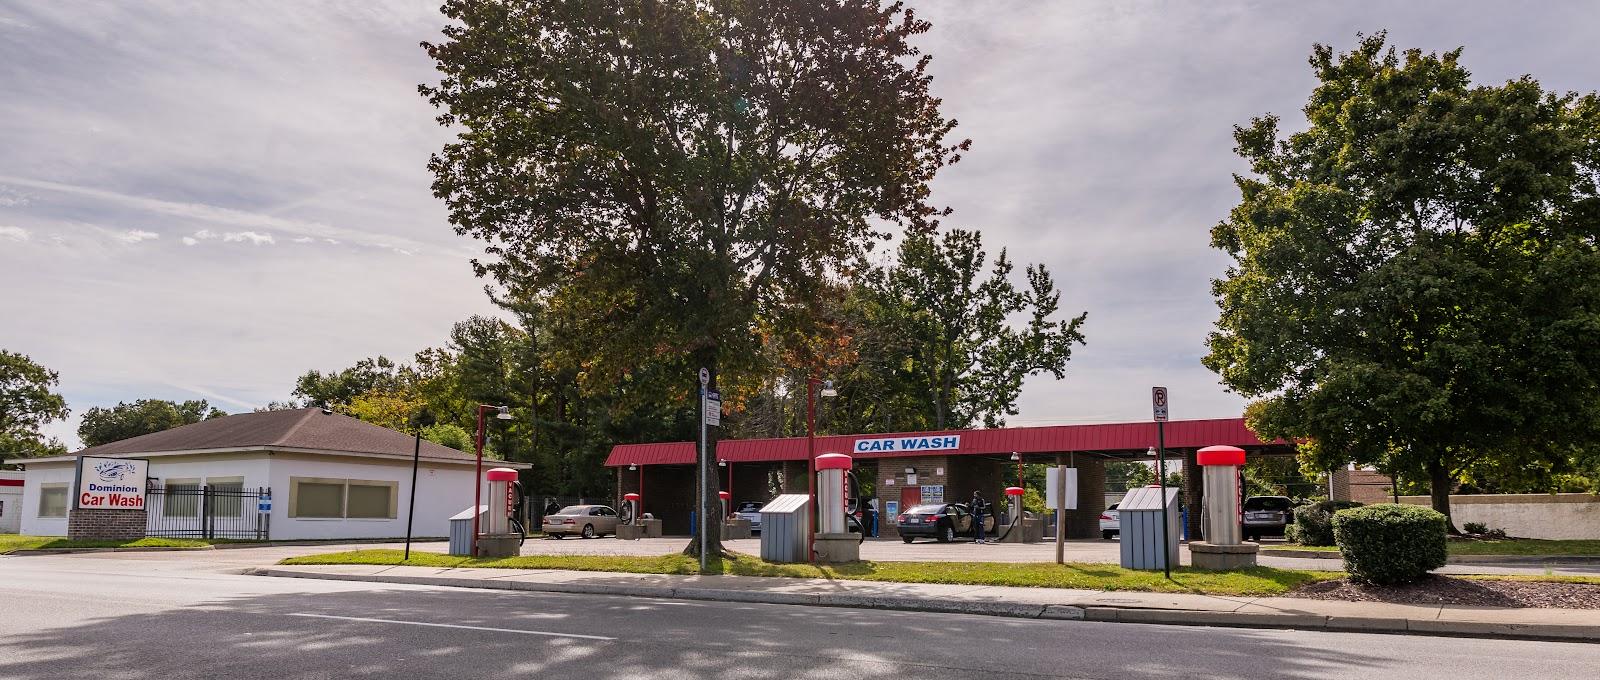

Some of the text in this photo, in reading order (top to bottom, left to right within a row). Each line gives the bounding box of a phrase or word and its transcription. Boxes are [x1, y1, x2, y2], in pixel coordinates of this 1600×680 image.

[857, 437, 957, 452] CAR WASH
[89, 484, 137, 492] Dominion
[81, 492, 143, 506] Car Wash
